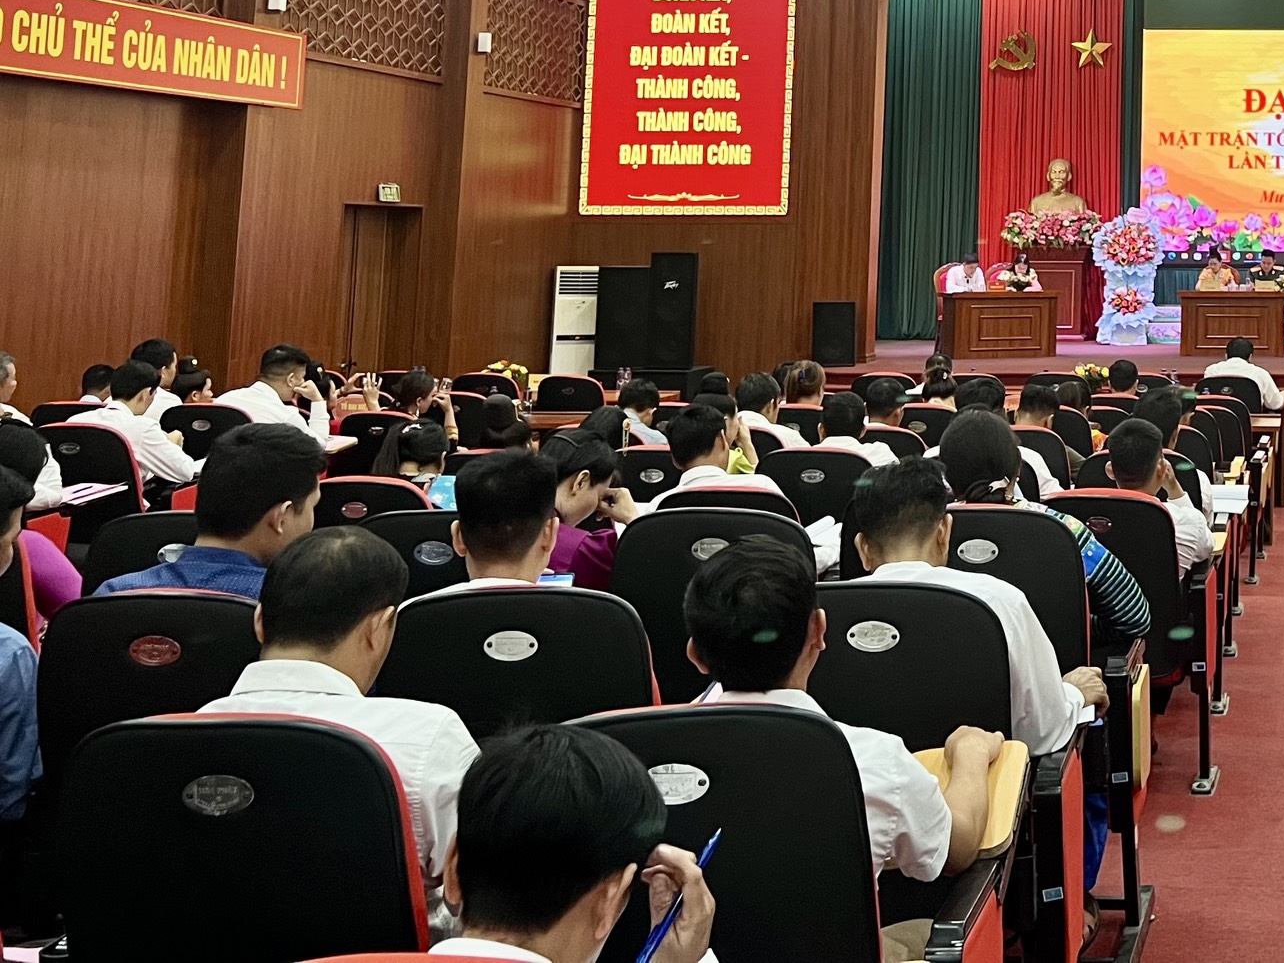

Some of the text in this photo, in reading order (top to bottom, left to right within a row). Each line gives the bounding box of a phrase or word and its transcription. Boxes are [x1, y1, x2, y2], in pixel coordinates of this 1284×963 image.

[651, 7, 731, 36] ĐOÀN KẾT,
[11, 2, 66, 58] CHỦ
[72, 10, 120, 66] THỂ
[122, 19, 167, 73] CỦA
[172, 35, 232, 82] NHÂN
[235, 43, 276, 88] DÂN
[280, 55, 288, 89] !
[629, 45, 658, 71] ĐẠI
[660, 41, 706, 67] ĐOÀN
[708, 40, 739, 67] KẾT
[635, 74, 741, 102] THÀNH CÔNG,
[636, 107, 742, 135] THÀNH CÔNG,
[618, 140, 752, 169] ĐẠI THÀNH CÔNG
[1158, 131, 1202, 149] MẶT
[1206, 131, 1259, 149] TRẬN
